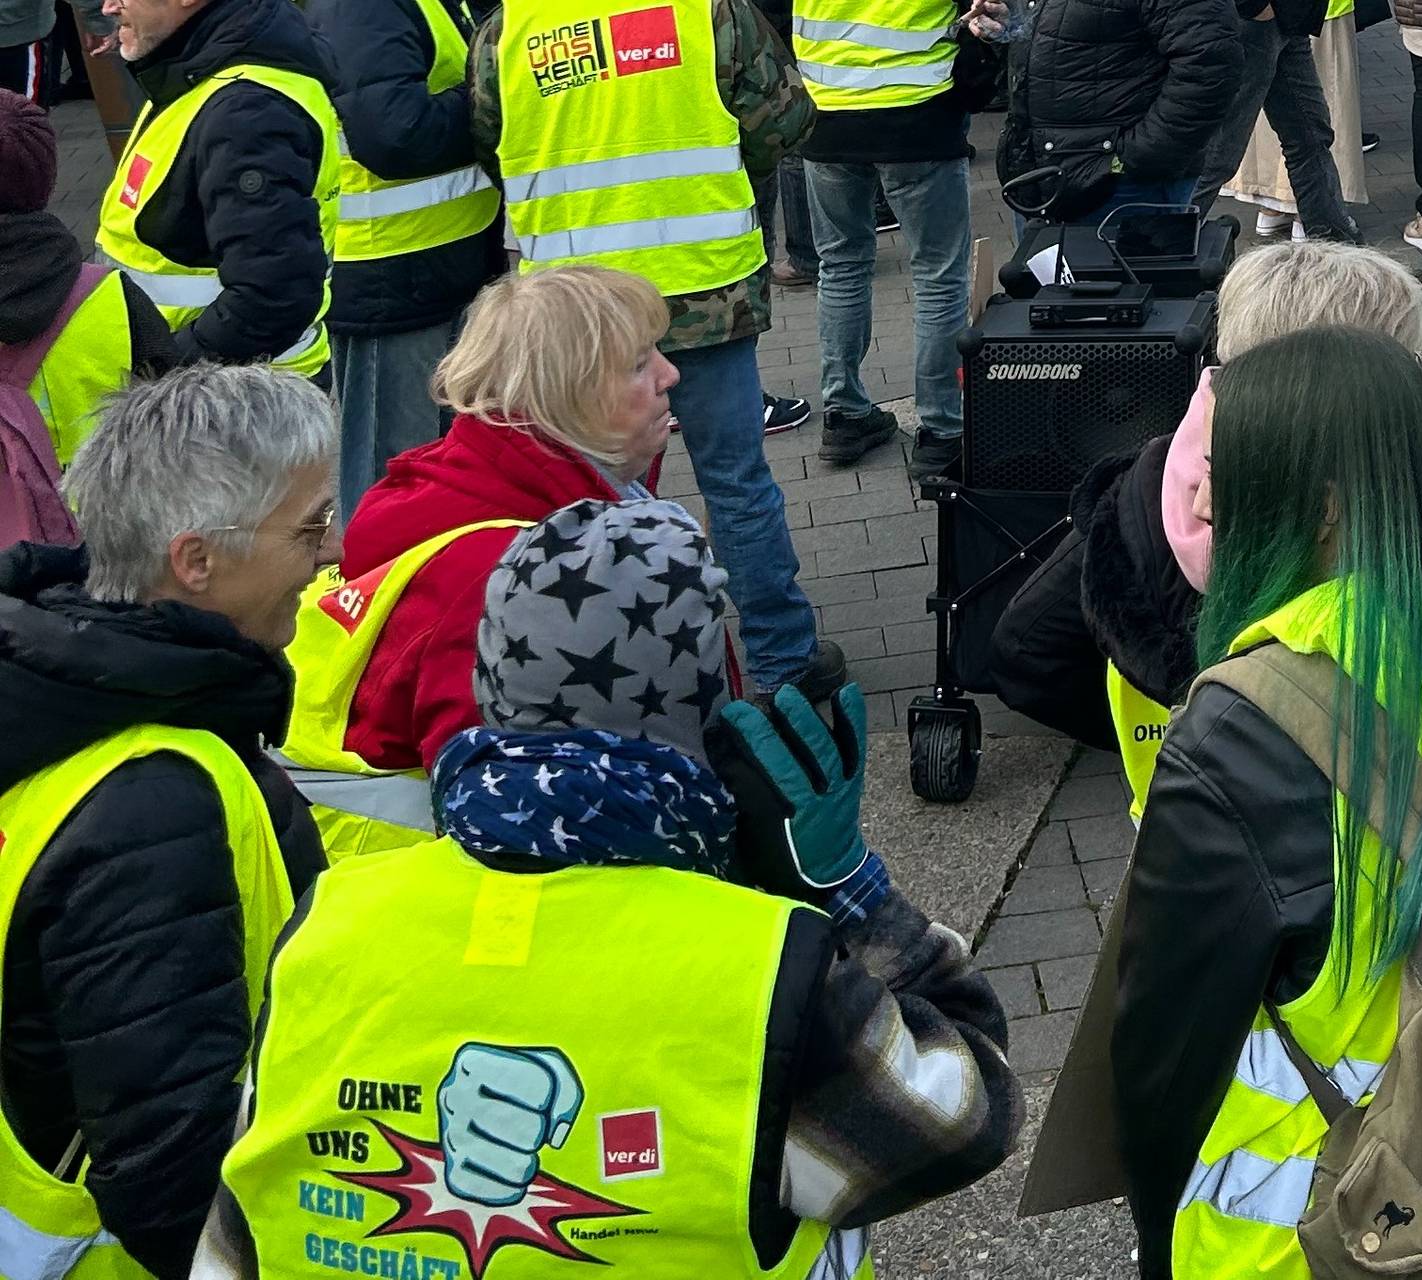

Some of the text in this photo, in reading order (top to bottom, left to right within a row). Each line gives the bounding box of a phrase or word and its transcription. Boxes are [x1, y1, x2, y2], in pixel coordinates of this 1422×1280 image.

[527, 21, 590, 51] OHNE
[528, 35, 593, 69] UNS
[533, 54, 598, 88] KEIN
[540, 73, 598, 98] GESCHÄFT
[986, 364, 1082, 380] SOUNDBOKS
[1134, 724, 1167, 742] OH
[338, 1078, 422, 1114] OHNE
[305, 1130, 370, 1164] UNS
[299, 1180, 365, 1222] KEIN
[570, 1227, 620, 1239] Handel
[305, 1233, 461, 1280] GESCHÄFT
